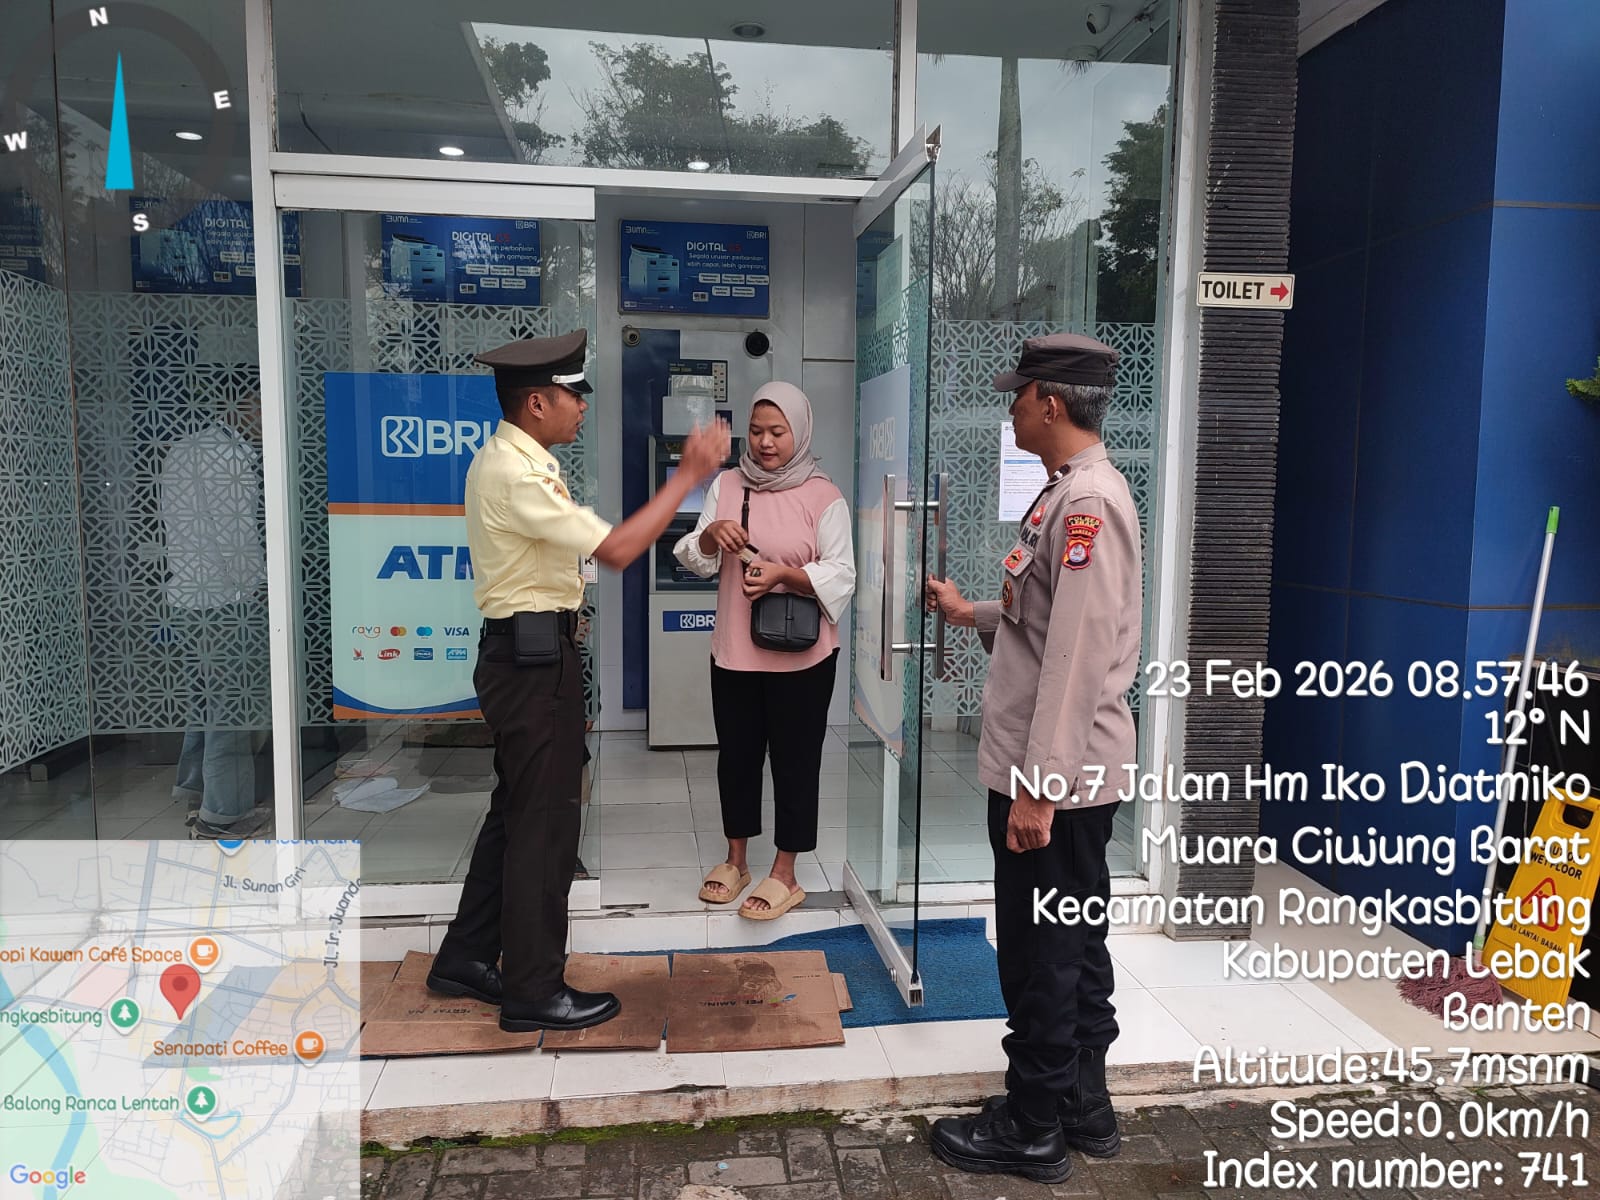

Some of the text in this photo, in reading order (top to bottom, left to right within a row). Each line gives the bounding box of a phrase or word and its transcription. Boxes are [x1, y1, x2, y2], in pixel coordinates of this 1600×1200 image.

[204, 217, 250, 229] DIGITAL
[452, 231, 496, 243] DIGITAL
[686, 241, 727, 252] DIGITAL
[688, 252, 710, 261] Segala
[1201, 280, 1265, 300] TOILET
[426, 419, 491, 456] BRI
[444, 626, 470, 637] VISA
[1549, 861, 1583, 881] FLOOR
[1519, 926, 1539, 943] LANTAI
[1540, 936, 1562, 953] BASAH
